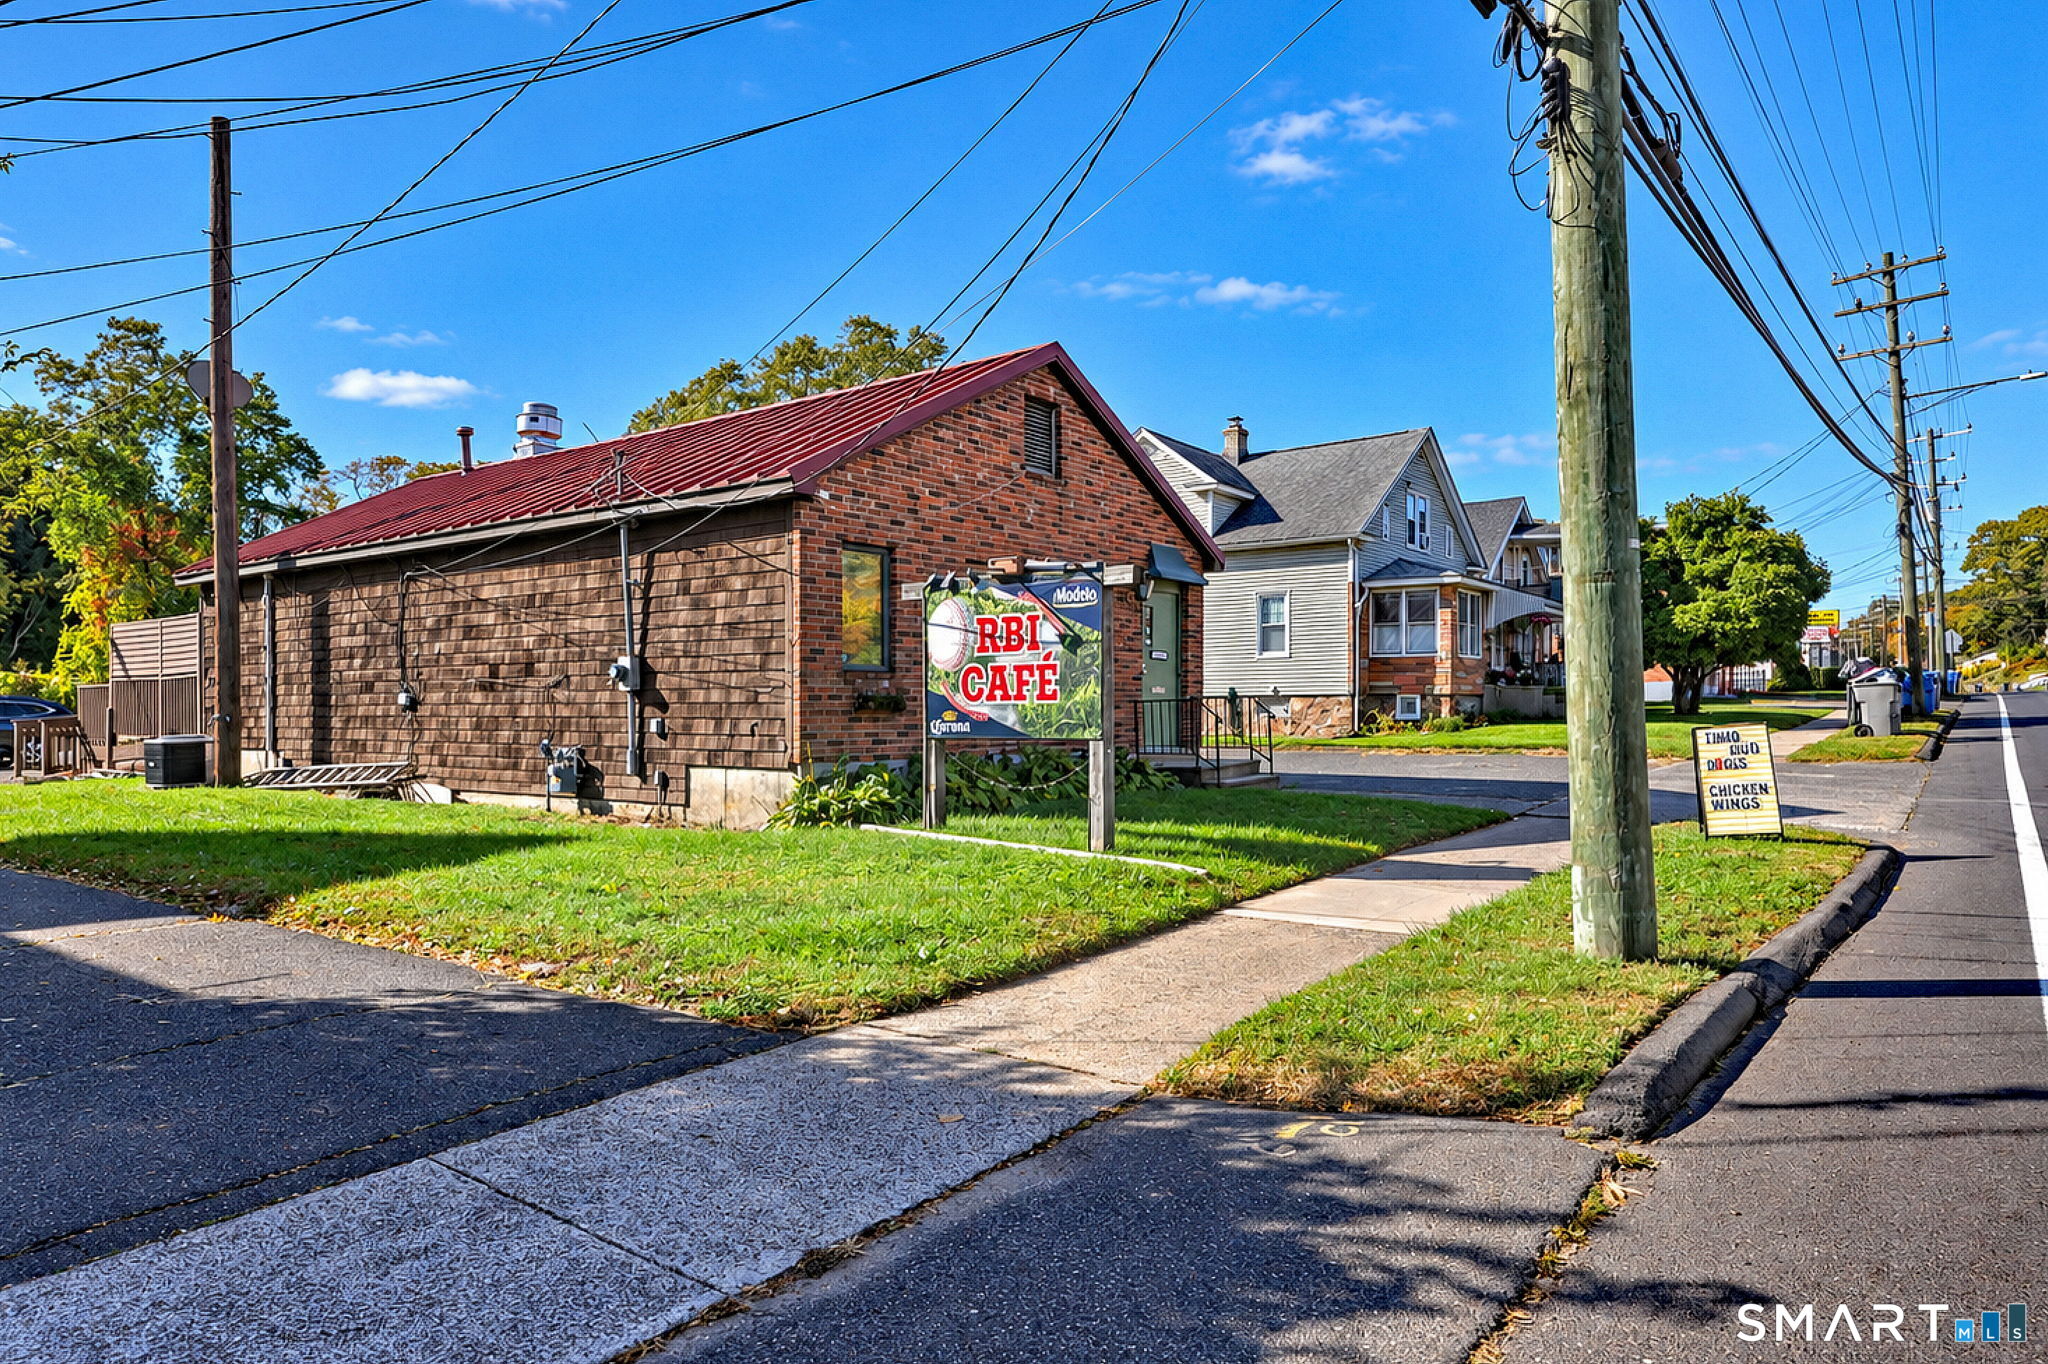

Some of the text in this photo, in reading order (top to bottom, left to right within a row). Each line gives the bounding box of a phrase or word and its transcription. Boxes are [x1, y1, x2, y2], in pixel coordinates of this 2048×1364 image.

[975, 613, 1042, 655] RBI
[960, 650, 1059, 703] CAFÉ
[930, 718, 971, 734] Corona
[1709, 782, 1770, 798] CHICKEN
[1711, 797, 1761, 811] WINGS
